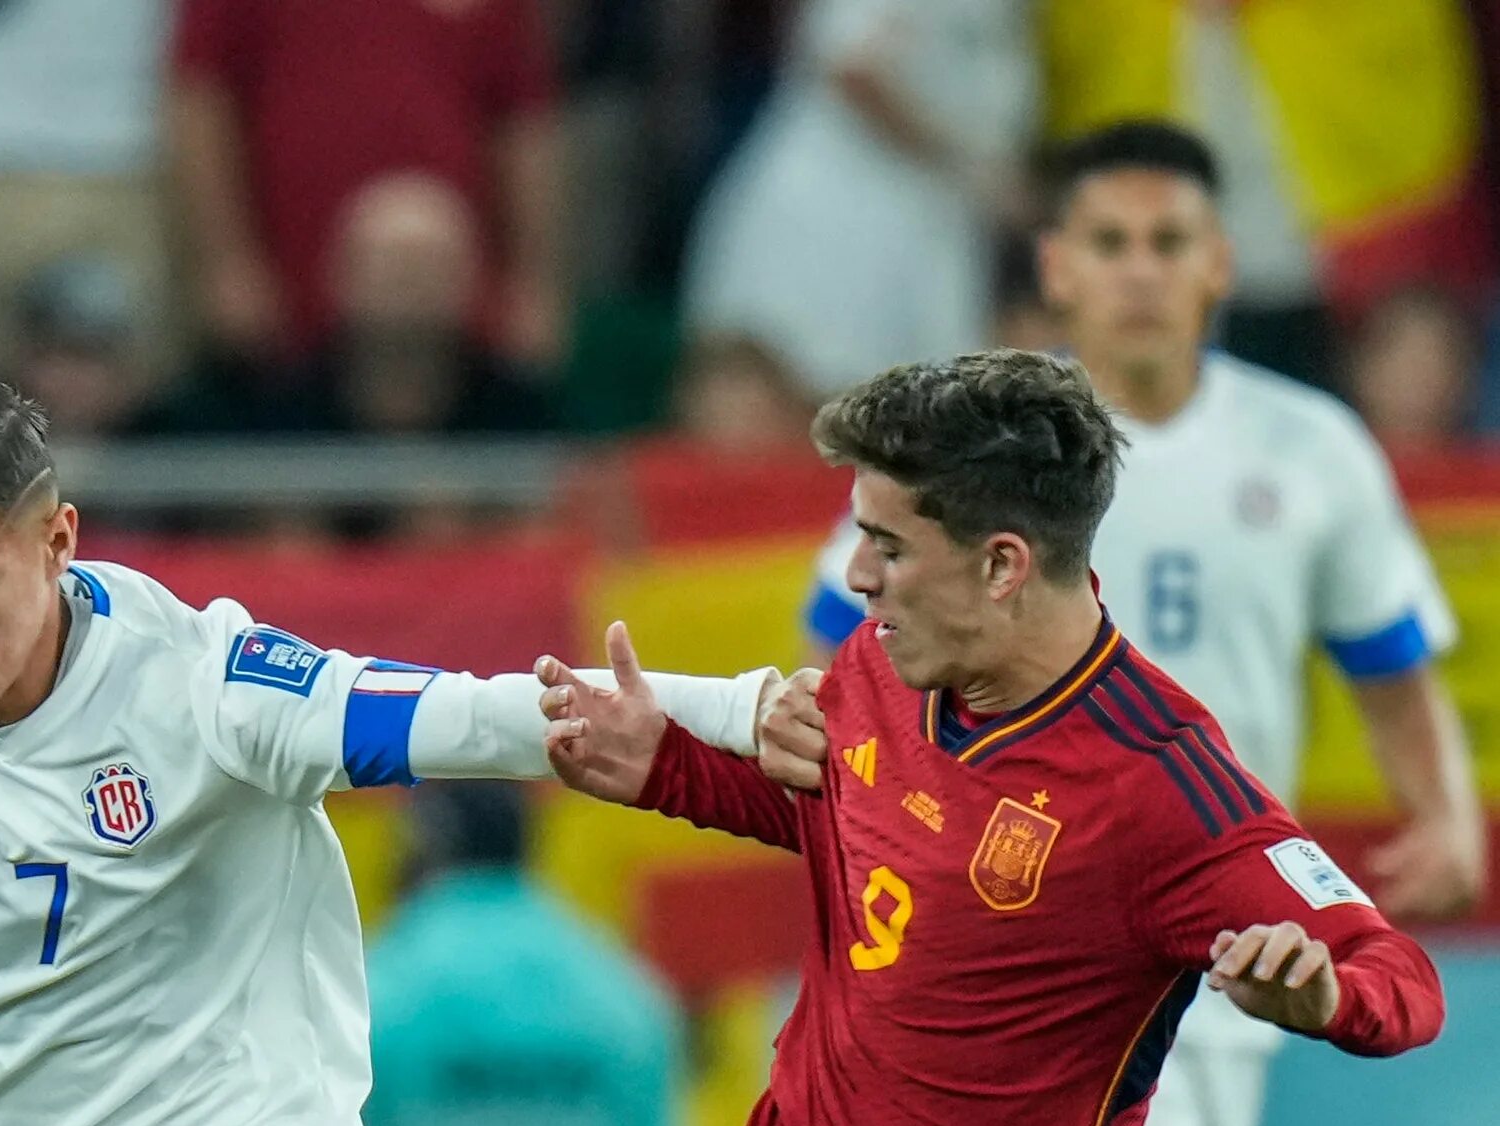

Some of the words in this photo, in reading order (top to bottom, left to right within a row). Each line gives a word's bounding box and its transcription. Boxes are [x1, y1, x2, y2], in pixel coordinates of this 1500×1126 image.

[1146, 552, 1199, 649] 6
[99, 780, 142, 833] CR
[14, 862, 68, 965] 7
[848, 865, 913, 971] 9
